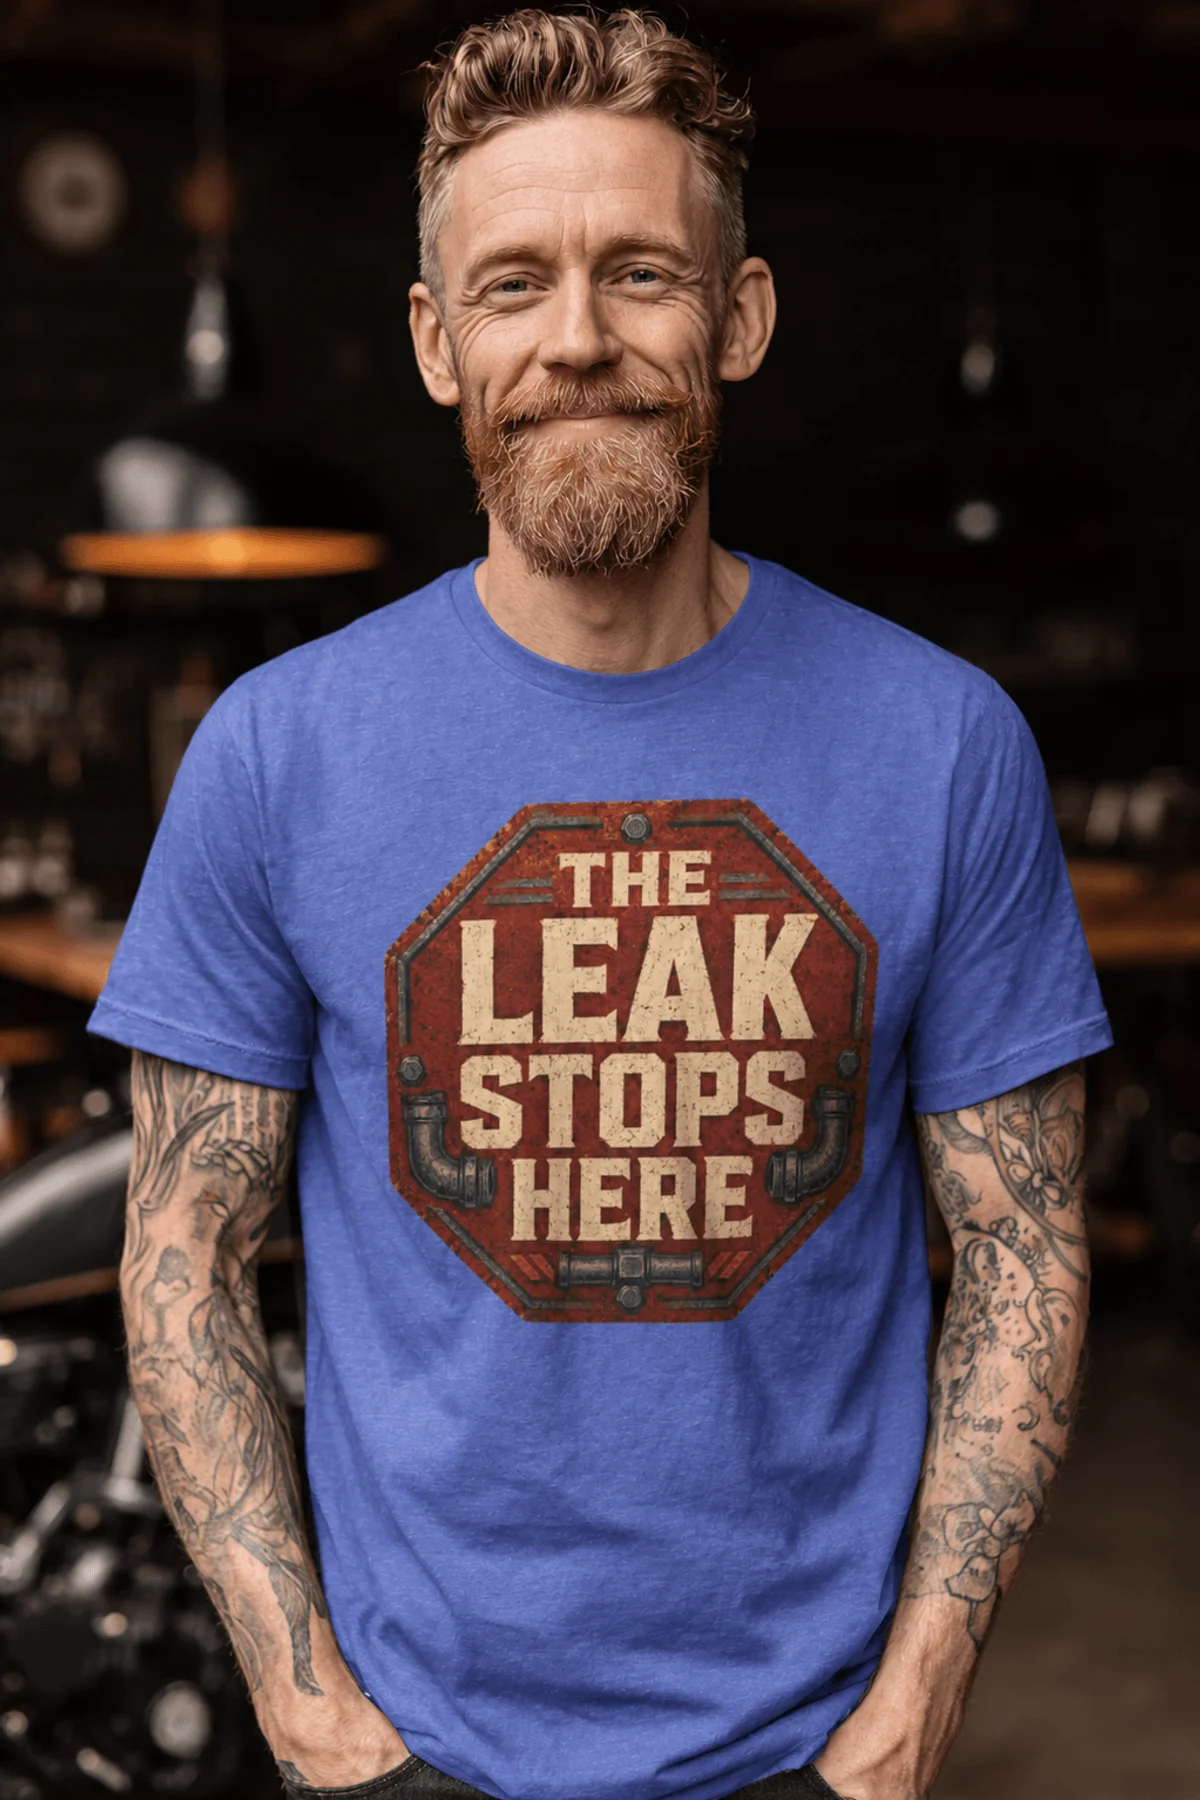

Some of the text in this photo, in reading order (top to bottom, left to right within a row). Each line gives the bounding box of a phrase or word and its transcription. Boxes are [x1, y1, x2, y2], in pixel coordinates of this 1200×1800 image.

[559, 850, 712, 908] THE
[458, 912, 819, 1046] LEAK
[460, 1050, 806, 1150] STOPS
[510, 1155, 754, 1241] HERE
